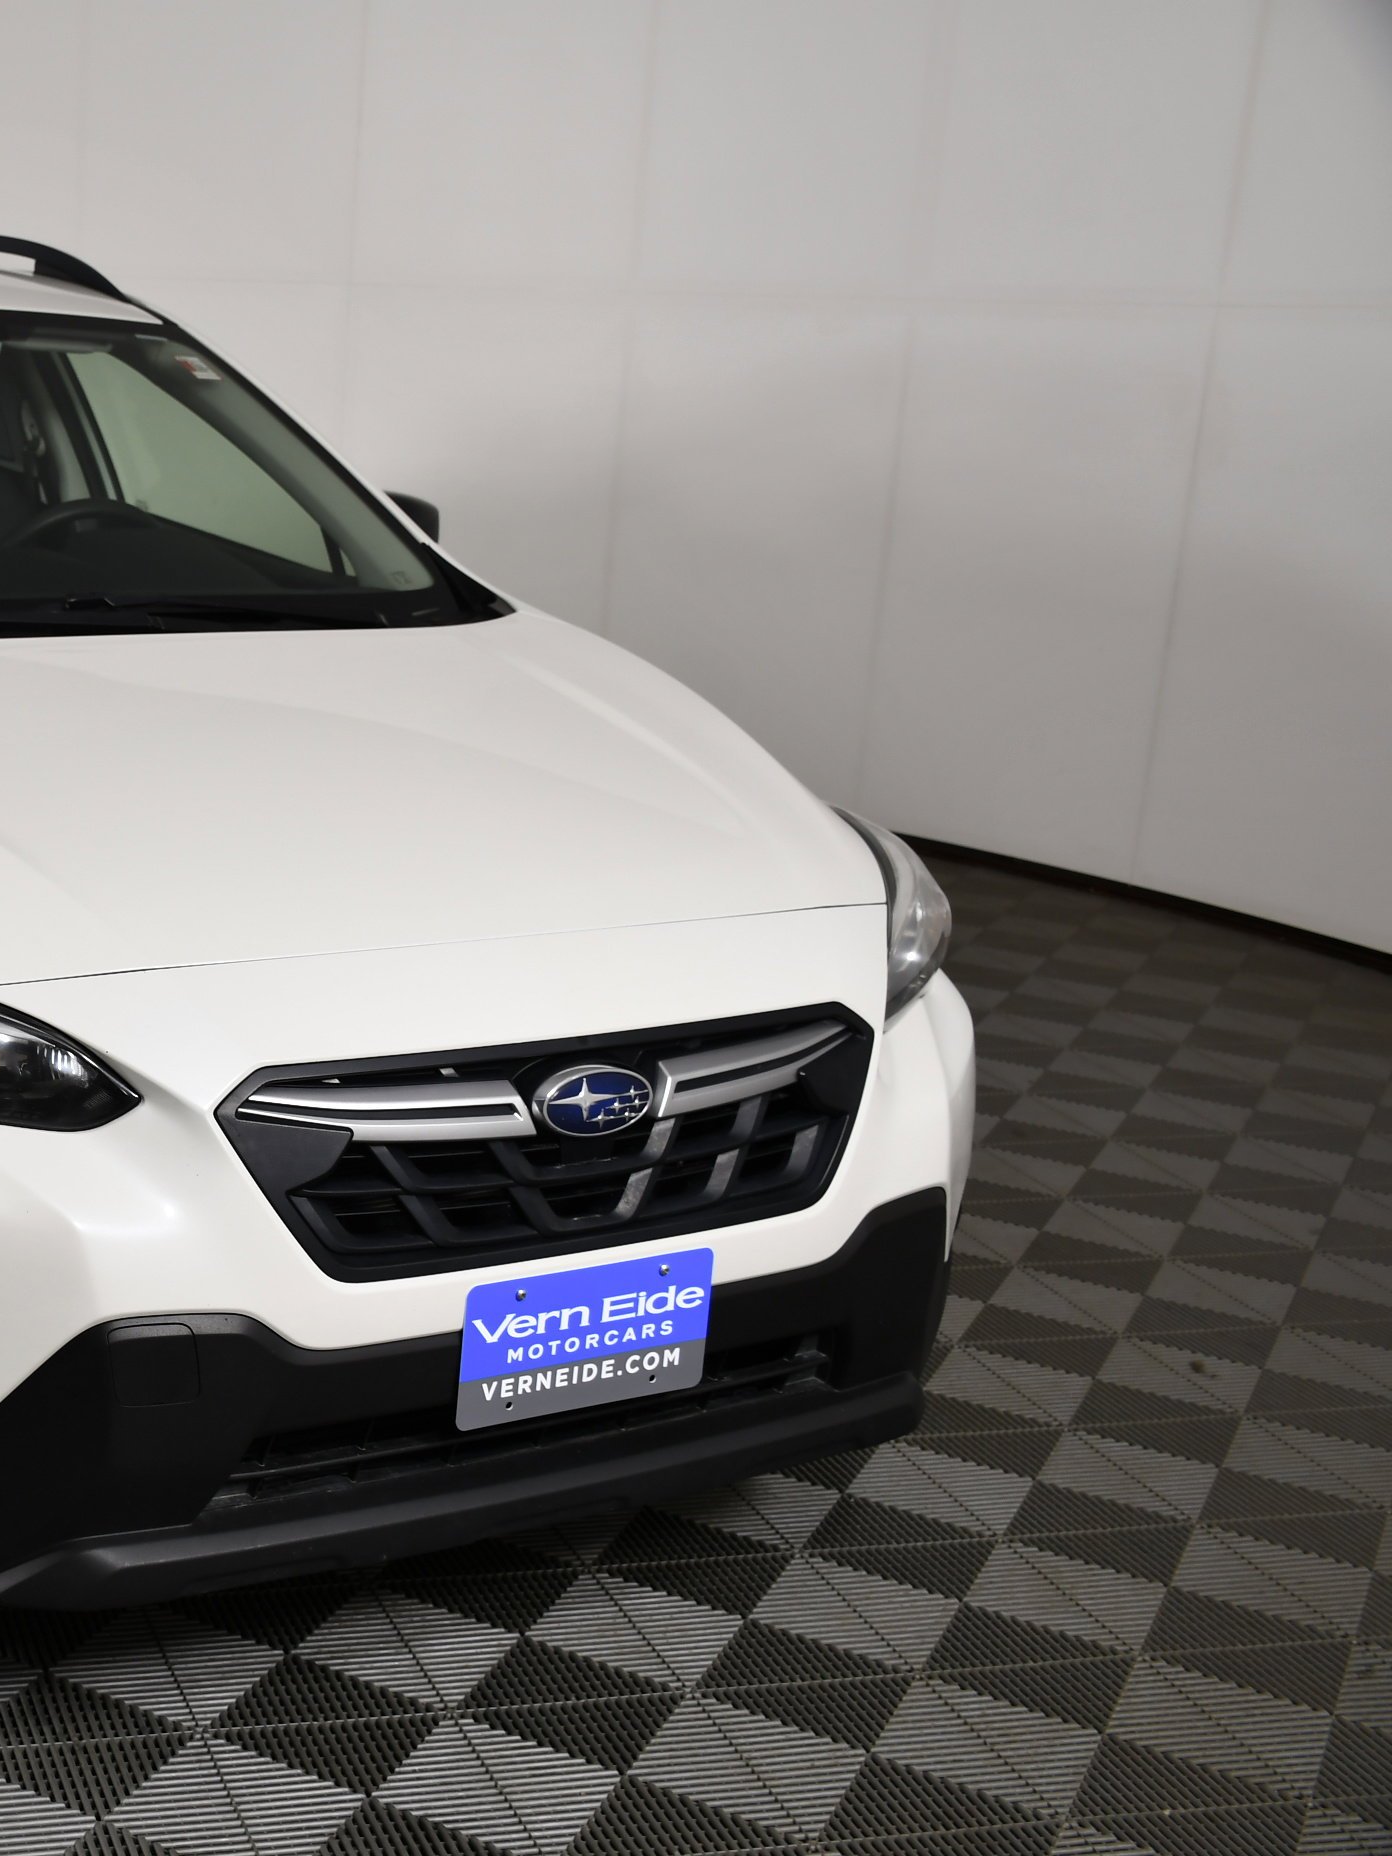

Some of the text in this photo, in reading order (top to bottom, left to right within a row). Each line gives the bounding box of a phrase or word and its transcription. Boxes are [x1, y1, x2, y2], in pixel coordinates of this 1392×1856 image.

[472, 1284, 705, 1344] Vern Eide
[507, 1320, 673, 1364] MOTORCARS
[482, 1347, 681, 1401] VERNEIDE.COM
